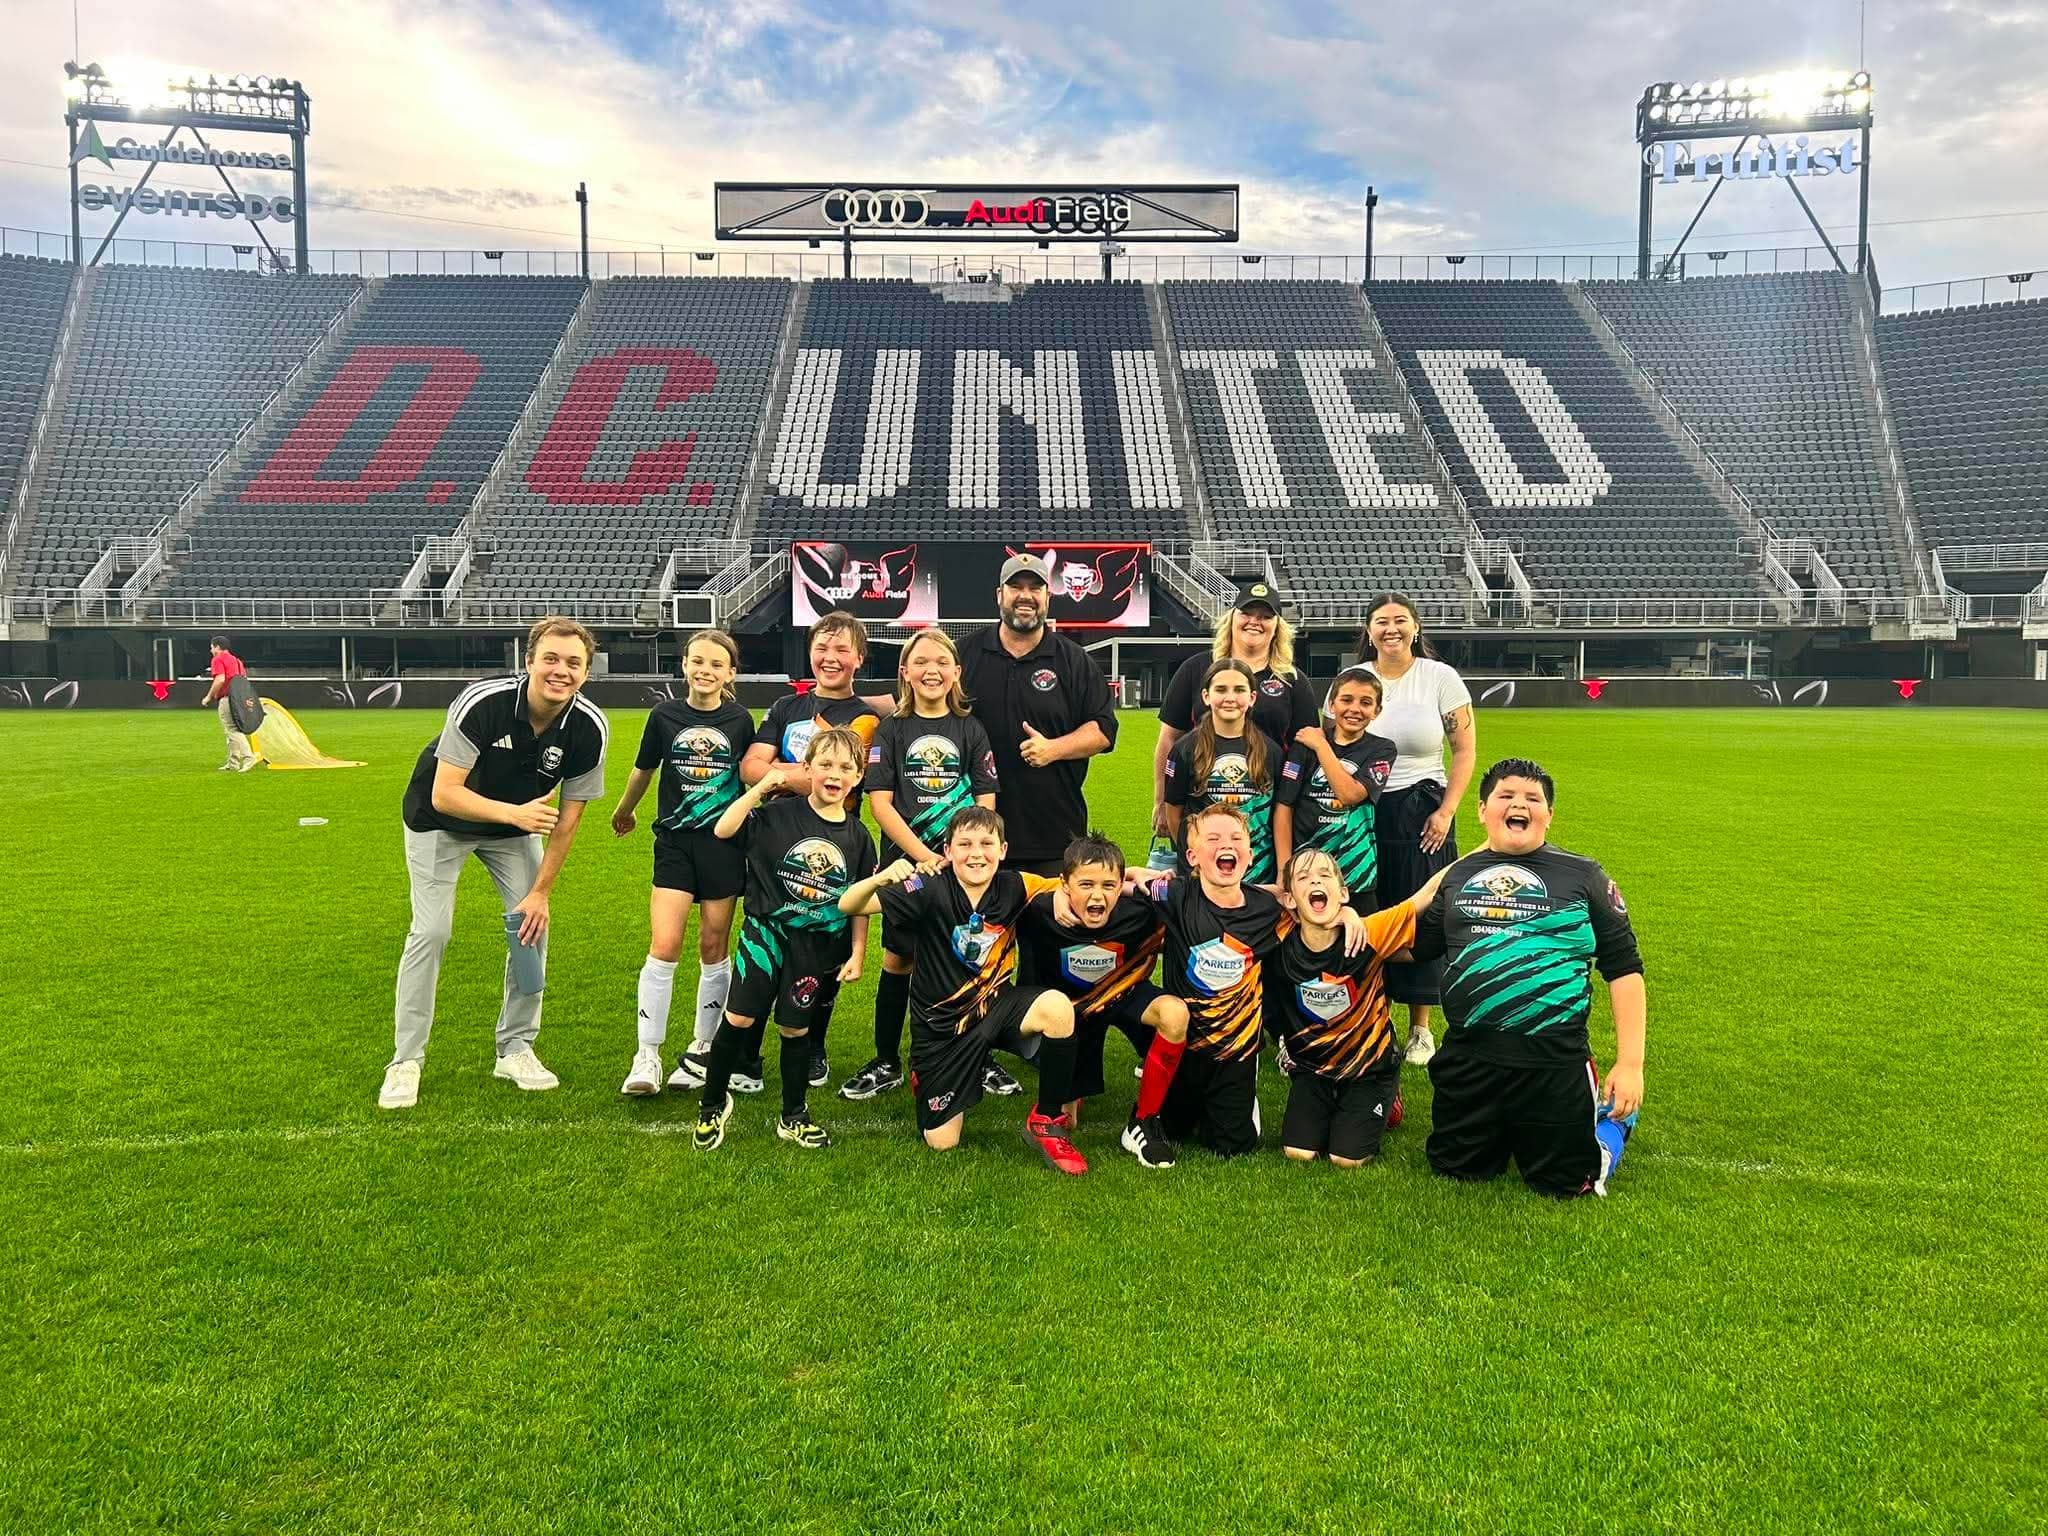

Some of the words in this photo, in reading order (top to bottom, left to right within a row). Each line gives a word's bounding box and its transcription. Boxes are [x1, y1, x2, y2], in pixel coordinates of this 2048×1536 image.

[115, 137, 291, 170] Guidehouse
[1643, 135, 1858, 183] Fruitist
[965, 198, 1044, 223] Audi
[1054, 198, 1132, 222] Field
[768, 348, 1613, 509] UNITED
[862, 590, 884, 599] Audi
[885, 590, 908, 599] Field
